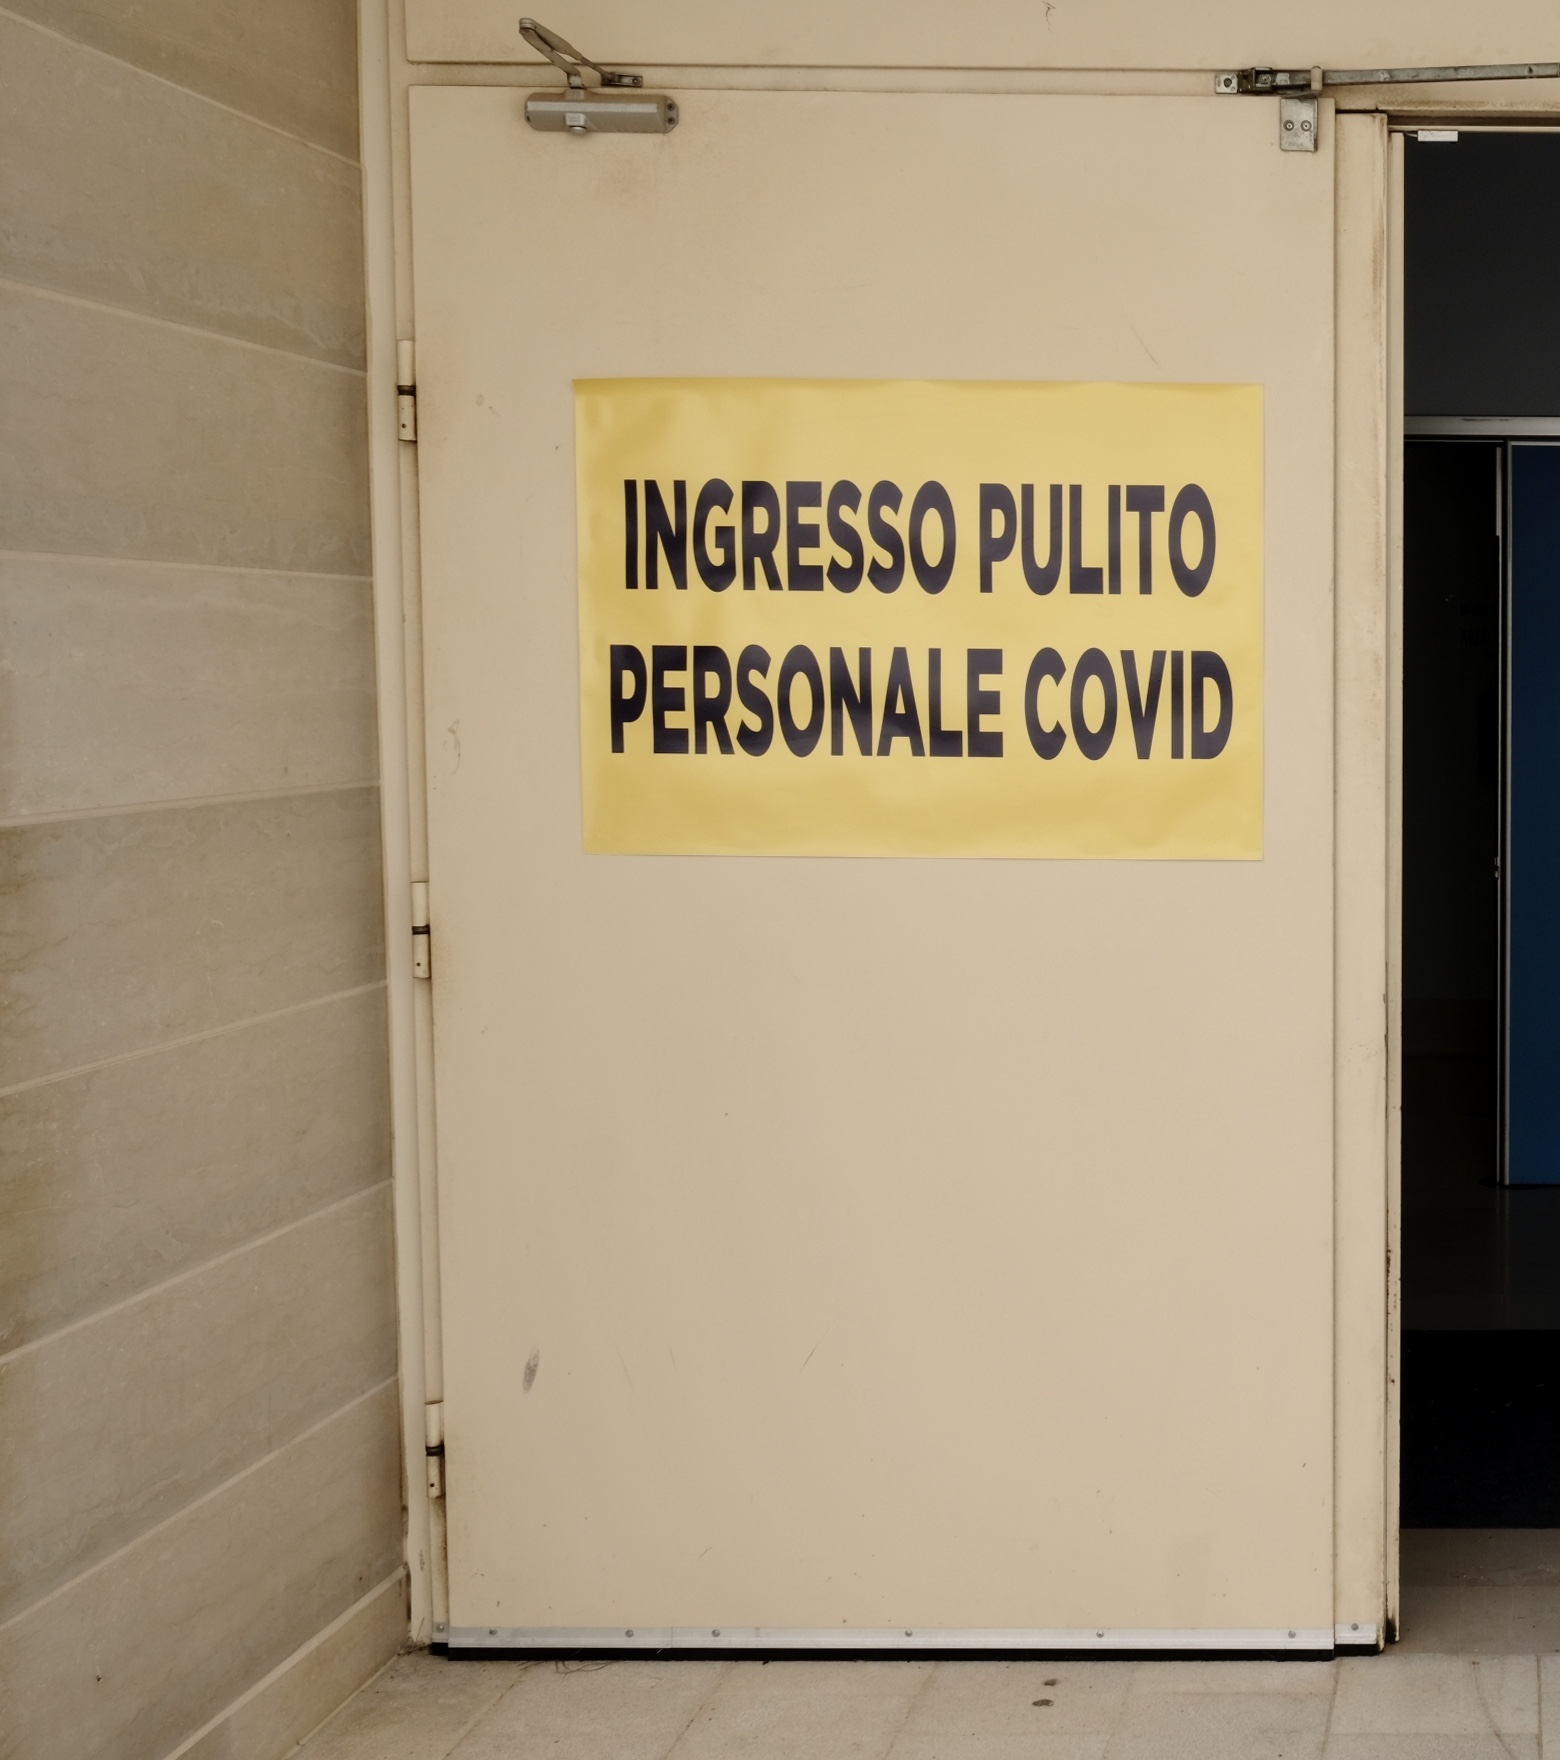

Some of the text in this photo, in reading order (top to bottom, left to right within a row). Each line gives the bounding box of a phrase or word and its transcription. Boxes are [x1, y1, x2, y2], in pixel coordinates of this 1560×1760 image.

[623, 478, 1216, 597] INGRESSO PULITO
[609, 644, 1233, 760] PERSONALE COVID
